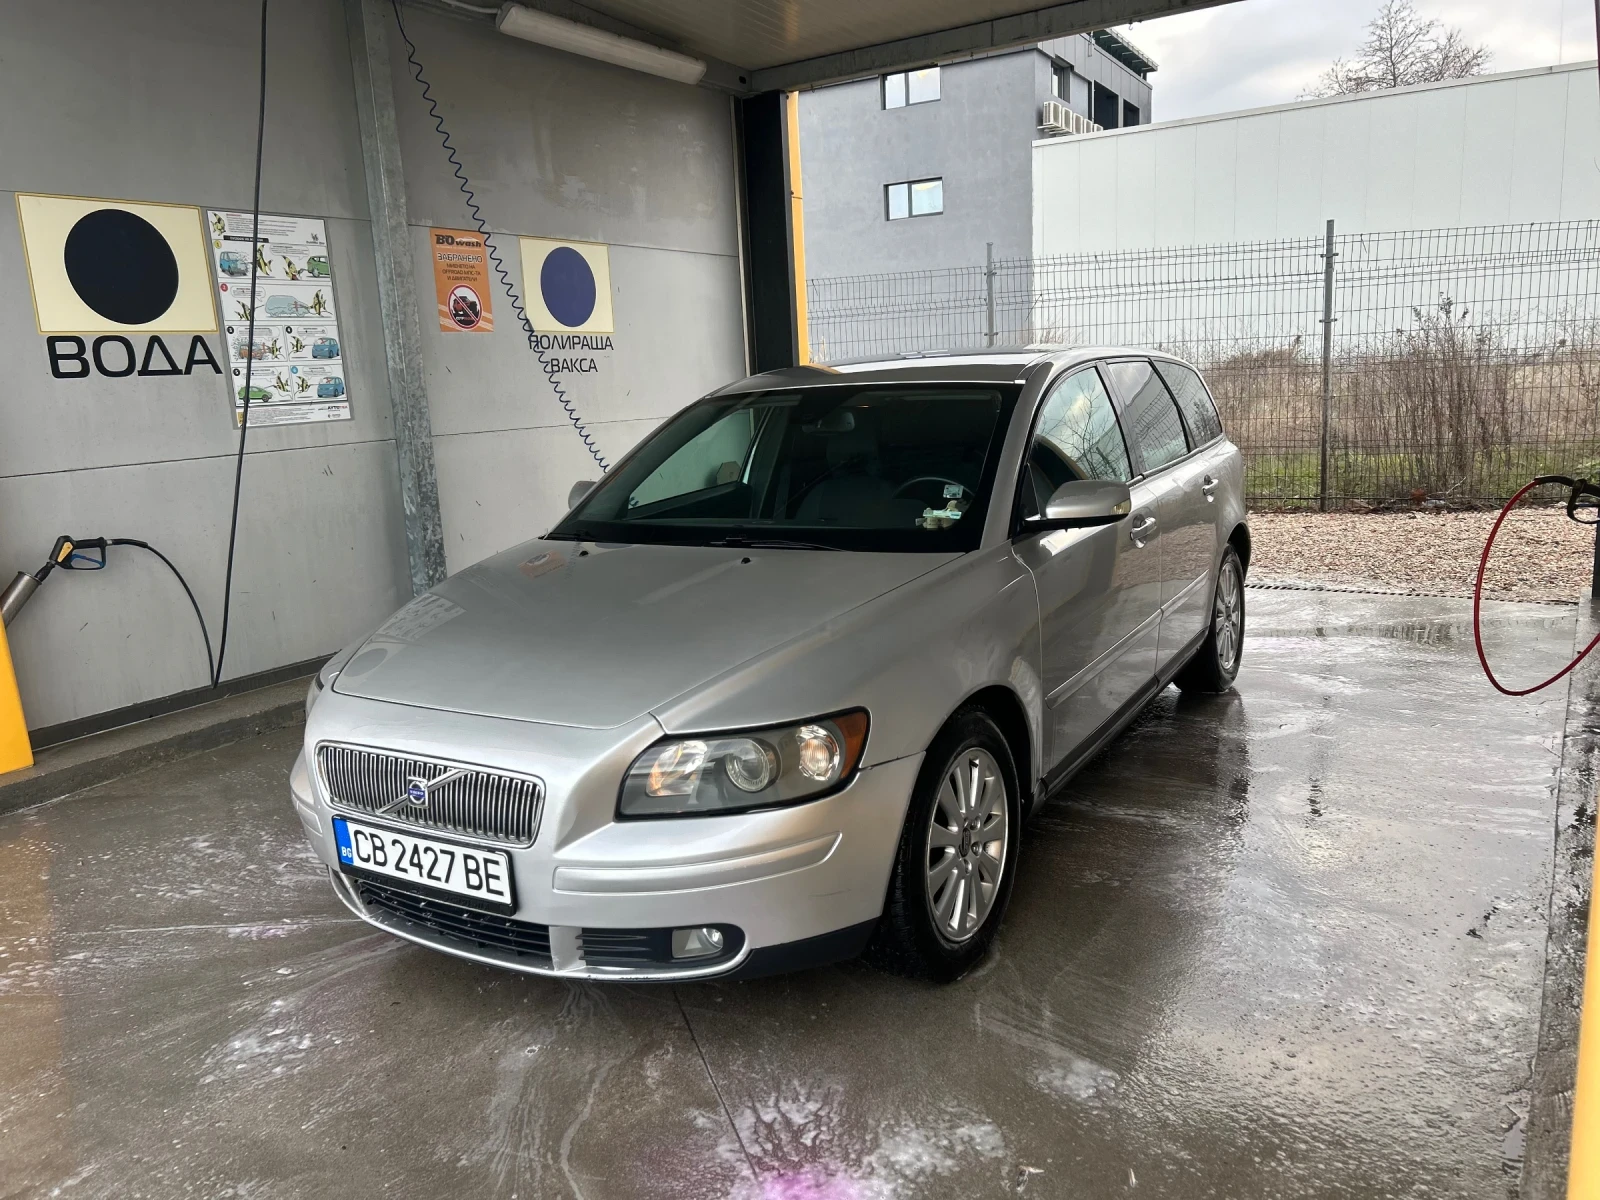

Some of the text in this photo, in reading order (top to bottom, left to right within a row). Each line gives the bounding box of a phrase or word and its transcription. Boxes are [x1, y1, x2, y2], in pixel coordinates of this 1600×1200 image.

[437, 253, 483, 263] ЗАБРАНЕНО
[529, 334, 614, 350] ПОЛИРАША
[46, 334, 223, 378] ВОДА
[550, 358, 598, 373] ВАКСА
[341, 846, 353, 858] BG
[353, 829, 505, 897] CB 2427 BE
